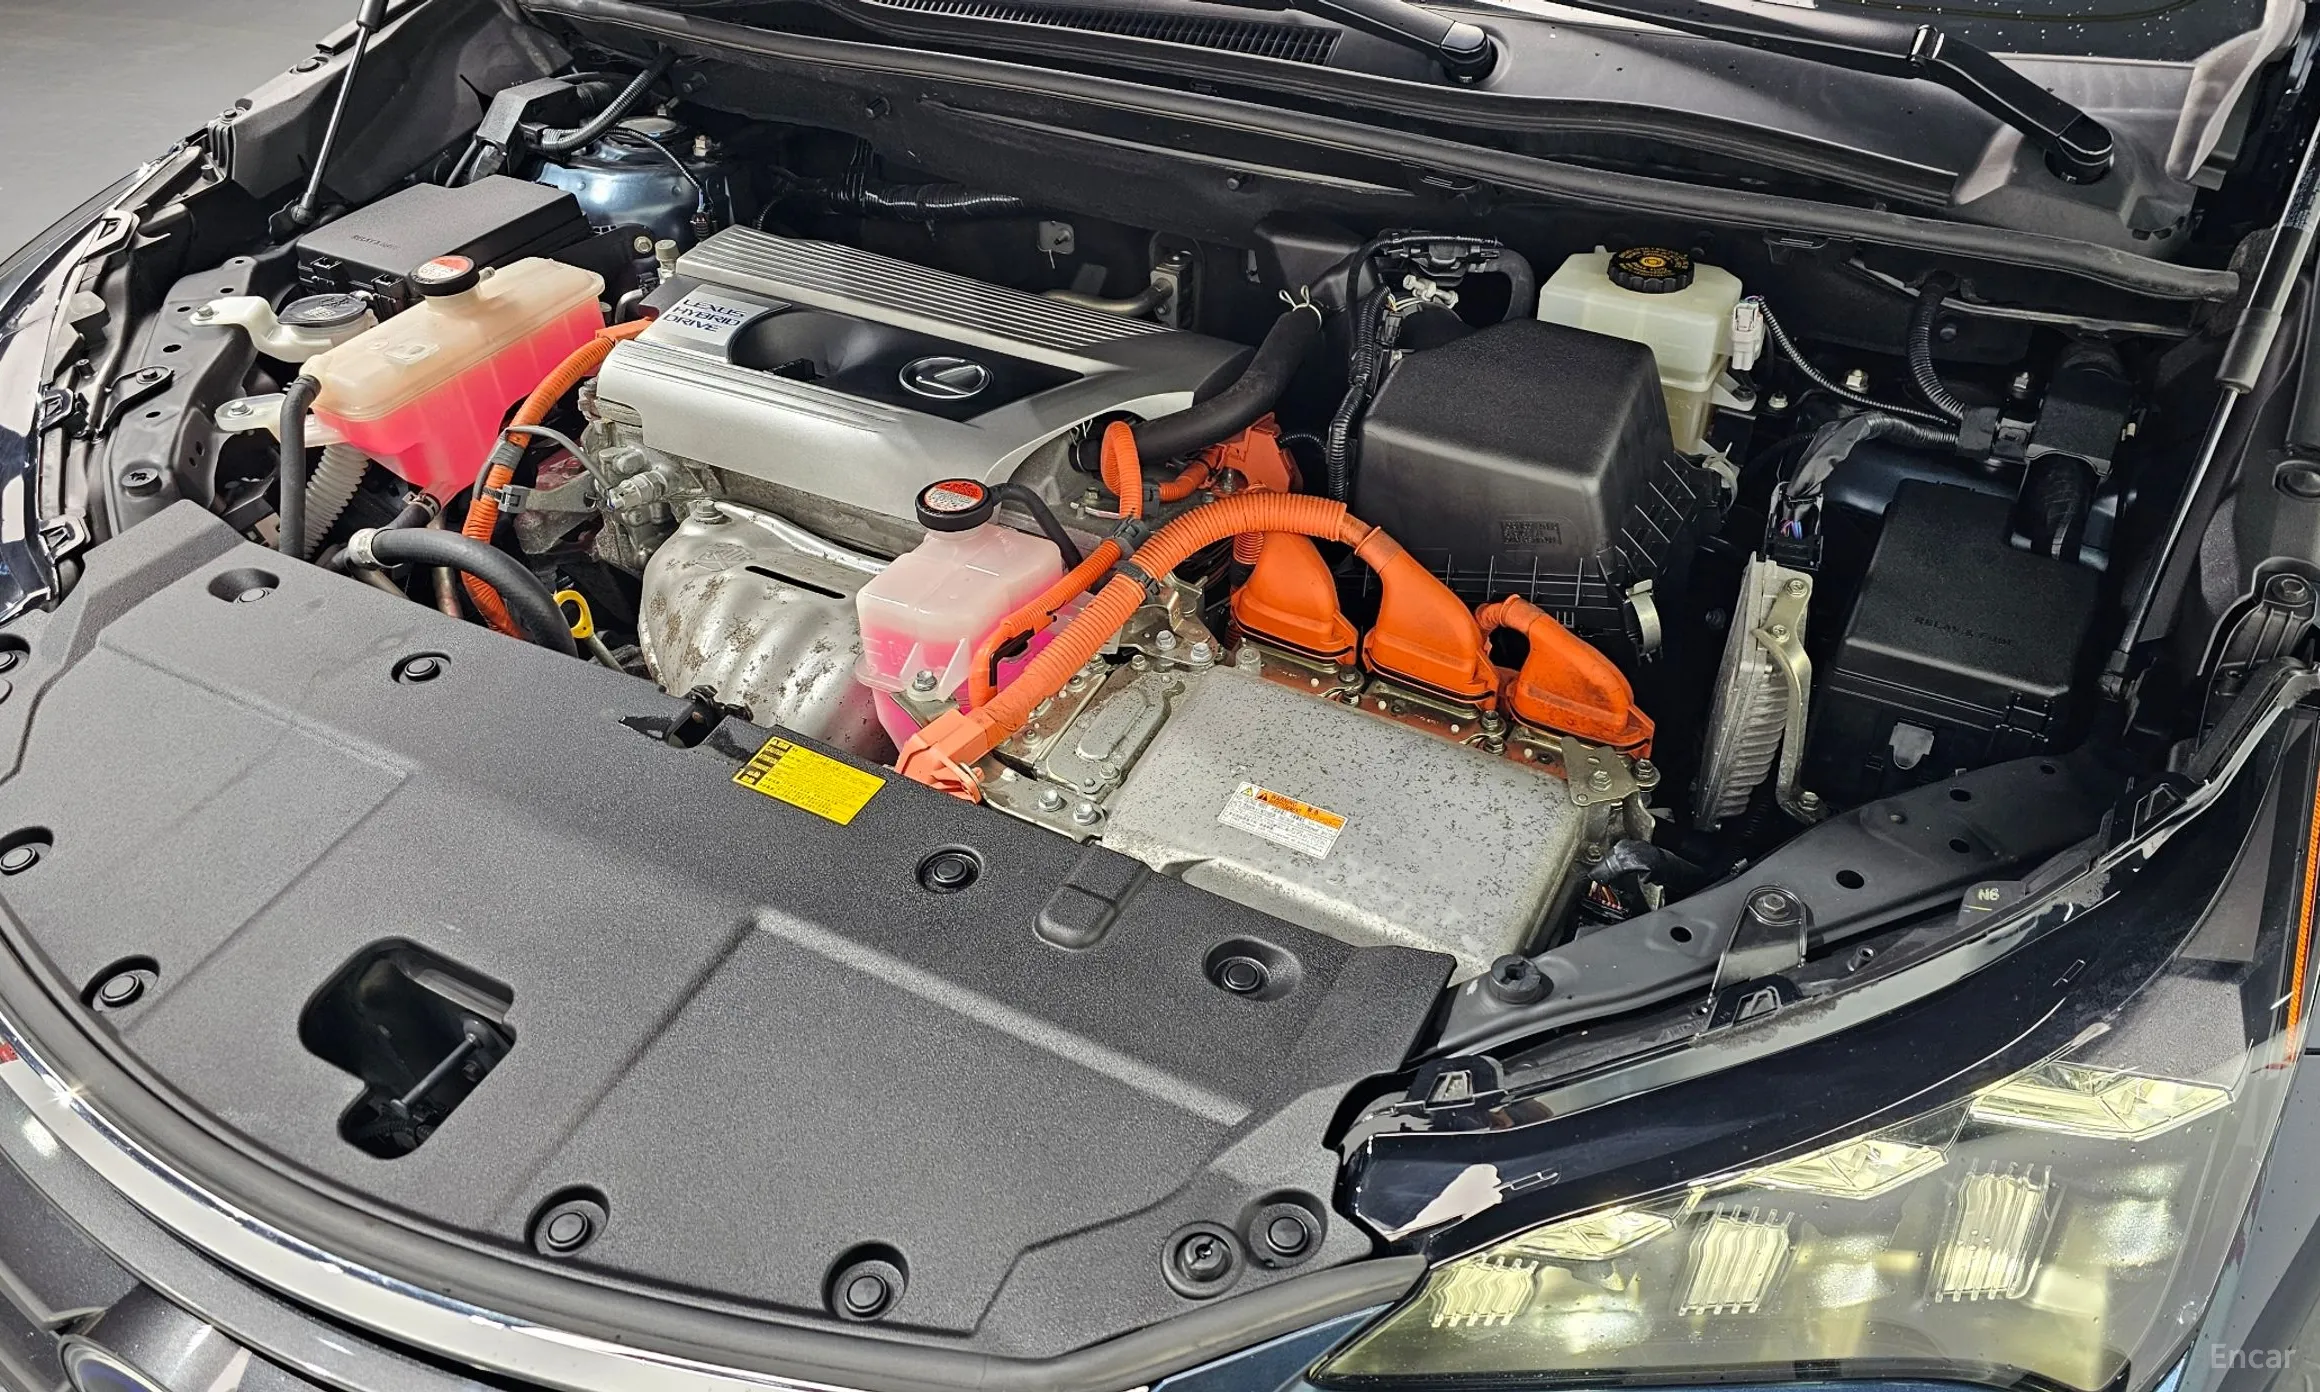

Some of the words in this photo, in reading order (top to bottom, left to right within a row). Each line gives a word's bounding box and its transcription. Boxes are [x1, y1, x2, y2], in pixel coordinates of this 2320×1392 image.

[672, 307, 741, 326] HYBRID
[683, 299, 748, 318] LEXUS
[663, 313, 722, 333] DRIVE
[1978, 887, 2000, 901] N6
